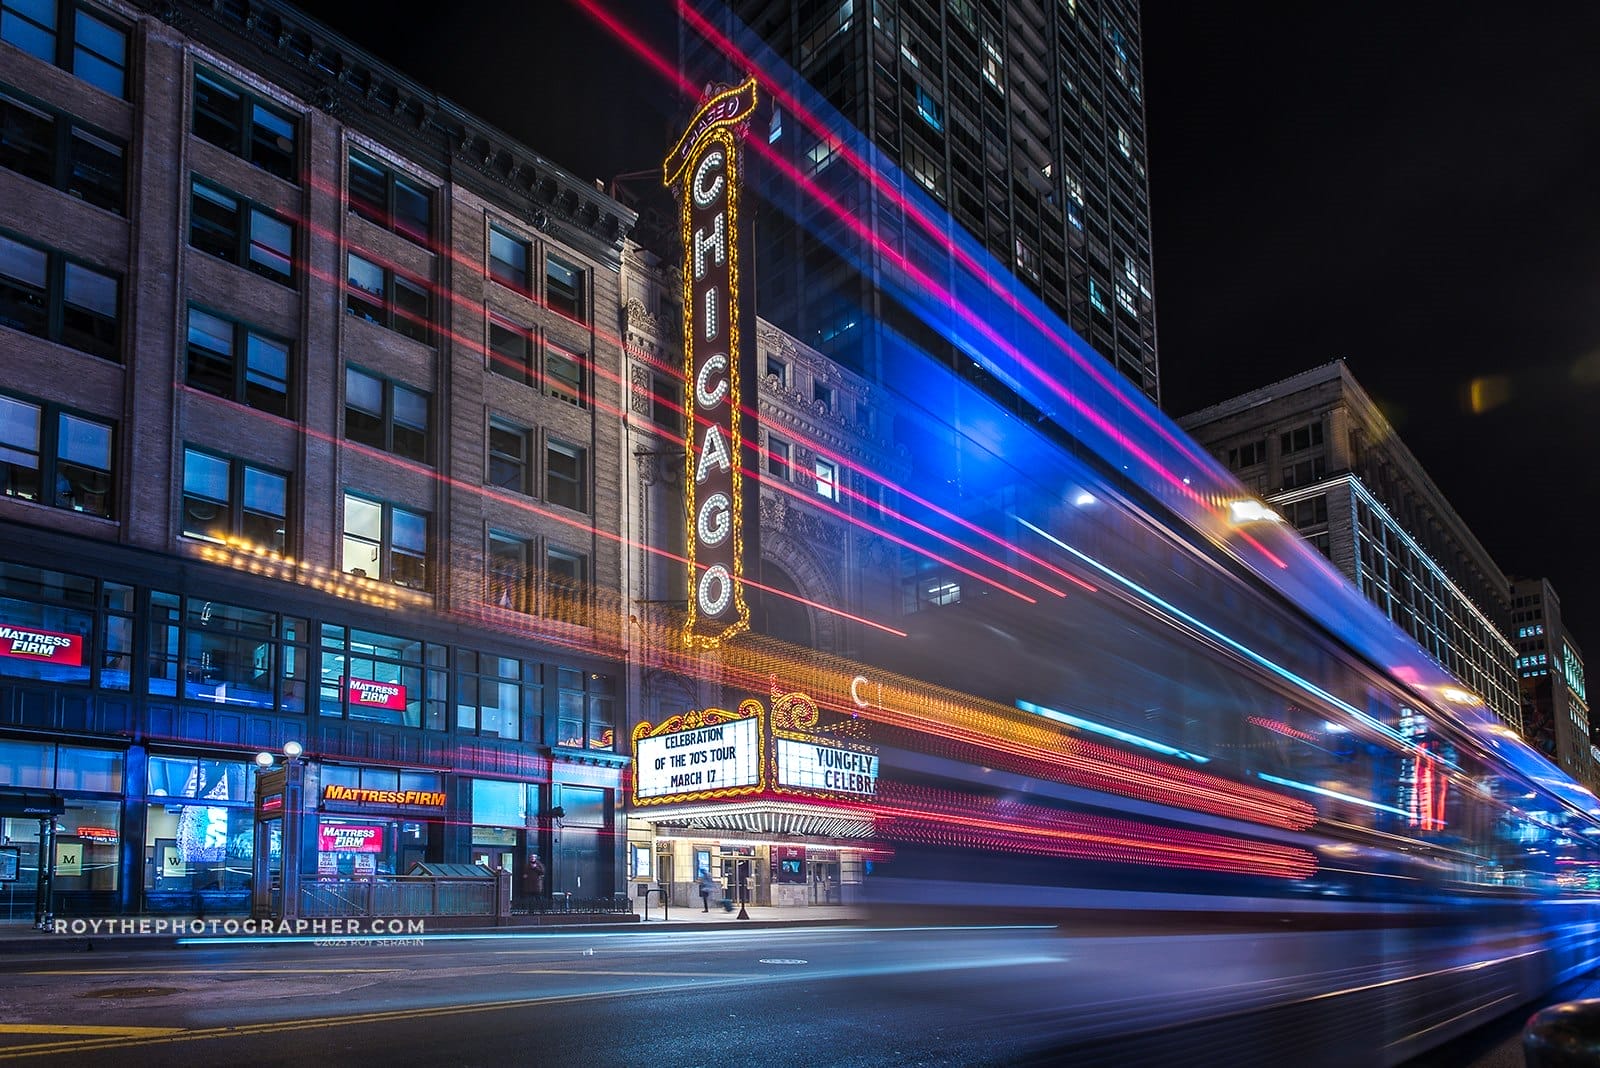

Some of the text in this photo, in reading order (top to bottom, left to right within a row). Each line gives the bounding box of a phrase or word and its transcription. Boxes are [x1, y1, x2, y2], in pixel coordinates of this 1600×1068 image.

[693, 151, 731, 616] CHICAGO
[0, 627, 72, 647] MATTRESS
[11, 640, 56, 656] FIRM
[350, 680, 399, 696] MATTRESS
[360, 691, 389, 704] FIRM
[665, 726, 724, 750] CELEBRATION
[654, 746, 737, 771] OF THE 70'S TOUR
[816, 747, 873, 774] YUNGFLY
[670, 769, 717, 788] MARCH 17
[323, 827, 375, 838] MATTRESS
[334, 837, 365, 847] FIRM
[63, 855, 75, 865] M
